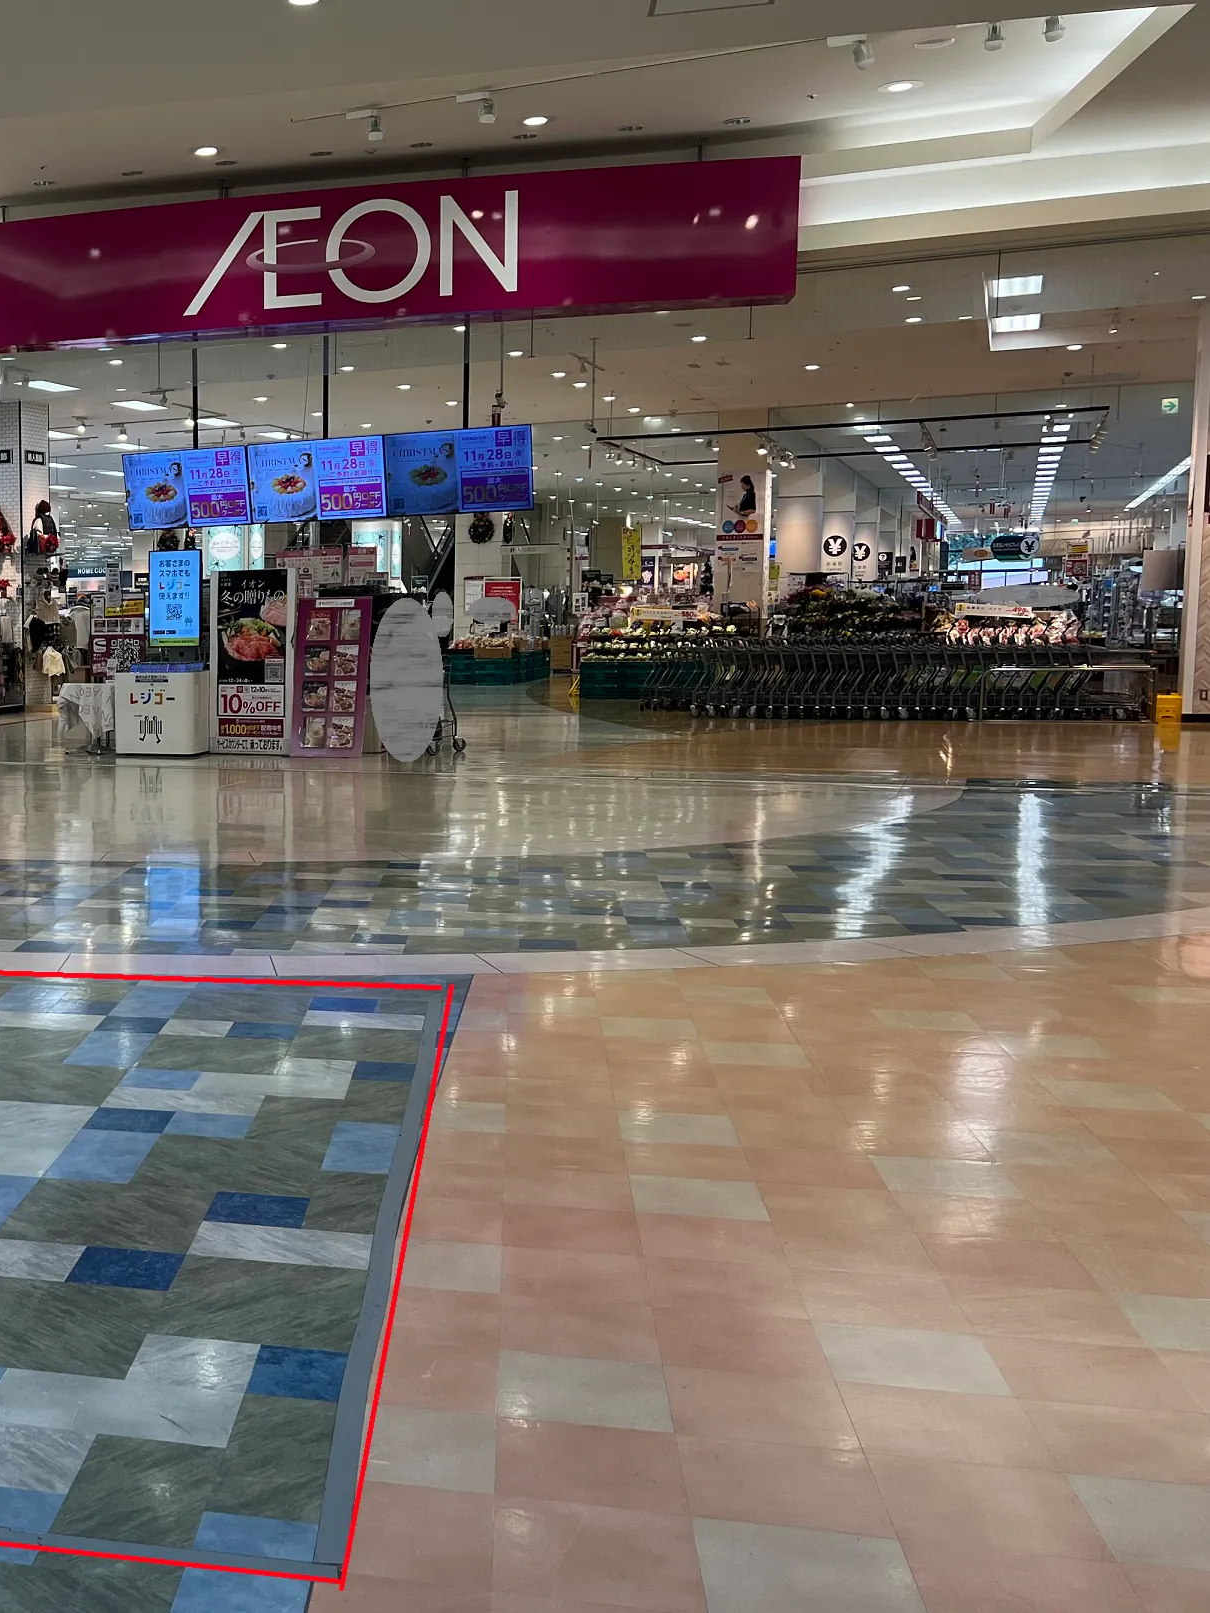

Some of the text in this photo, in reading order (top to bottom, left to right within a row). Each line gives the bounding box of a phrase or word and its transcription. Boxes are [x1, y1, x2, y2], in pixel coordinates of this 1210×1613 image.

[392, 447, 450, 458] CHRISTMAS
[256, 457, 307, 468] CHRISTMAS
[130, 465, 178, 476] CHRISTMAS
[158, 559, 190, 568] お客さまの
[159, 570, 190, 578] スマホでも
[240, 579, 265, 589] イオン
[220, 589, 285, 607] 冬の贈りもの
[130, 689, 175, 705] レジゴー
